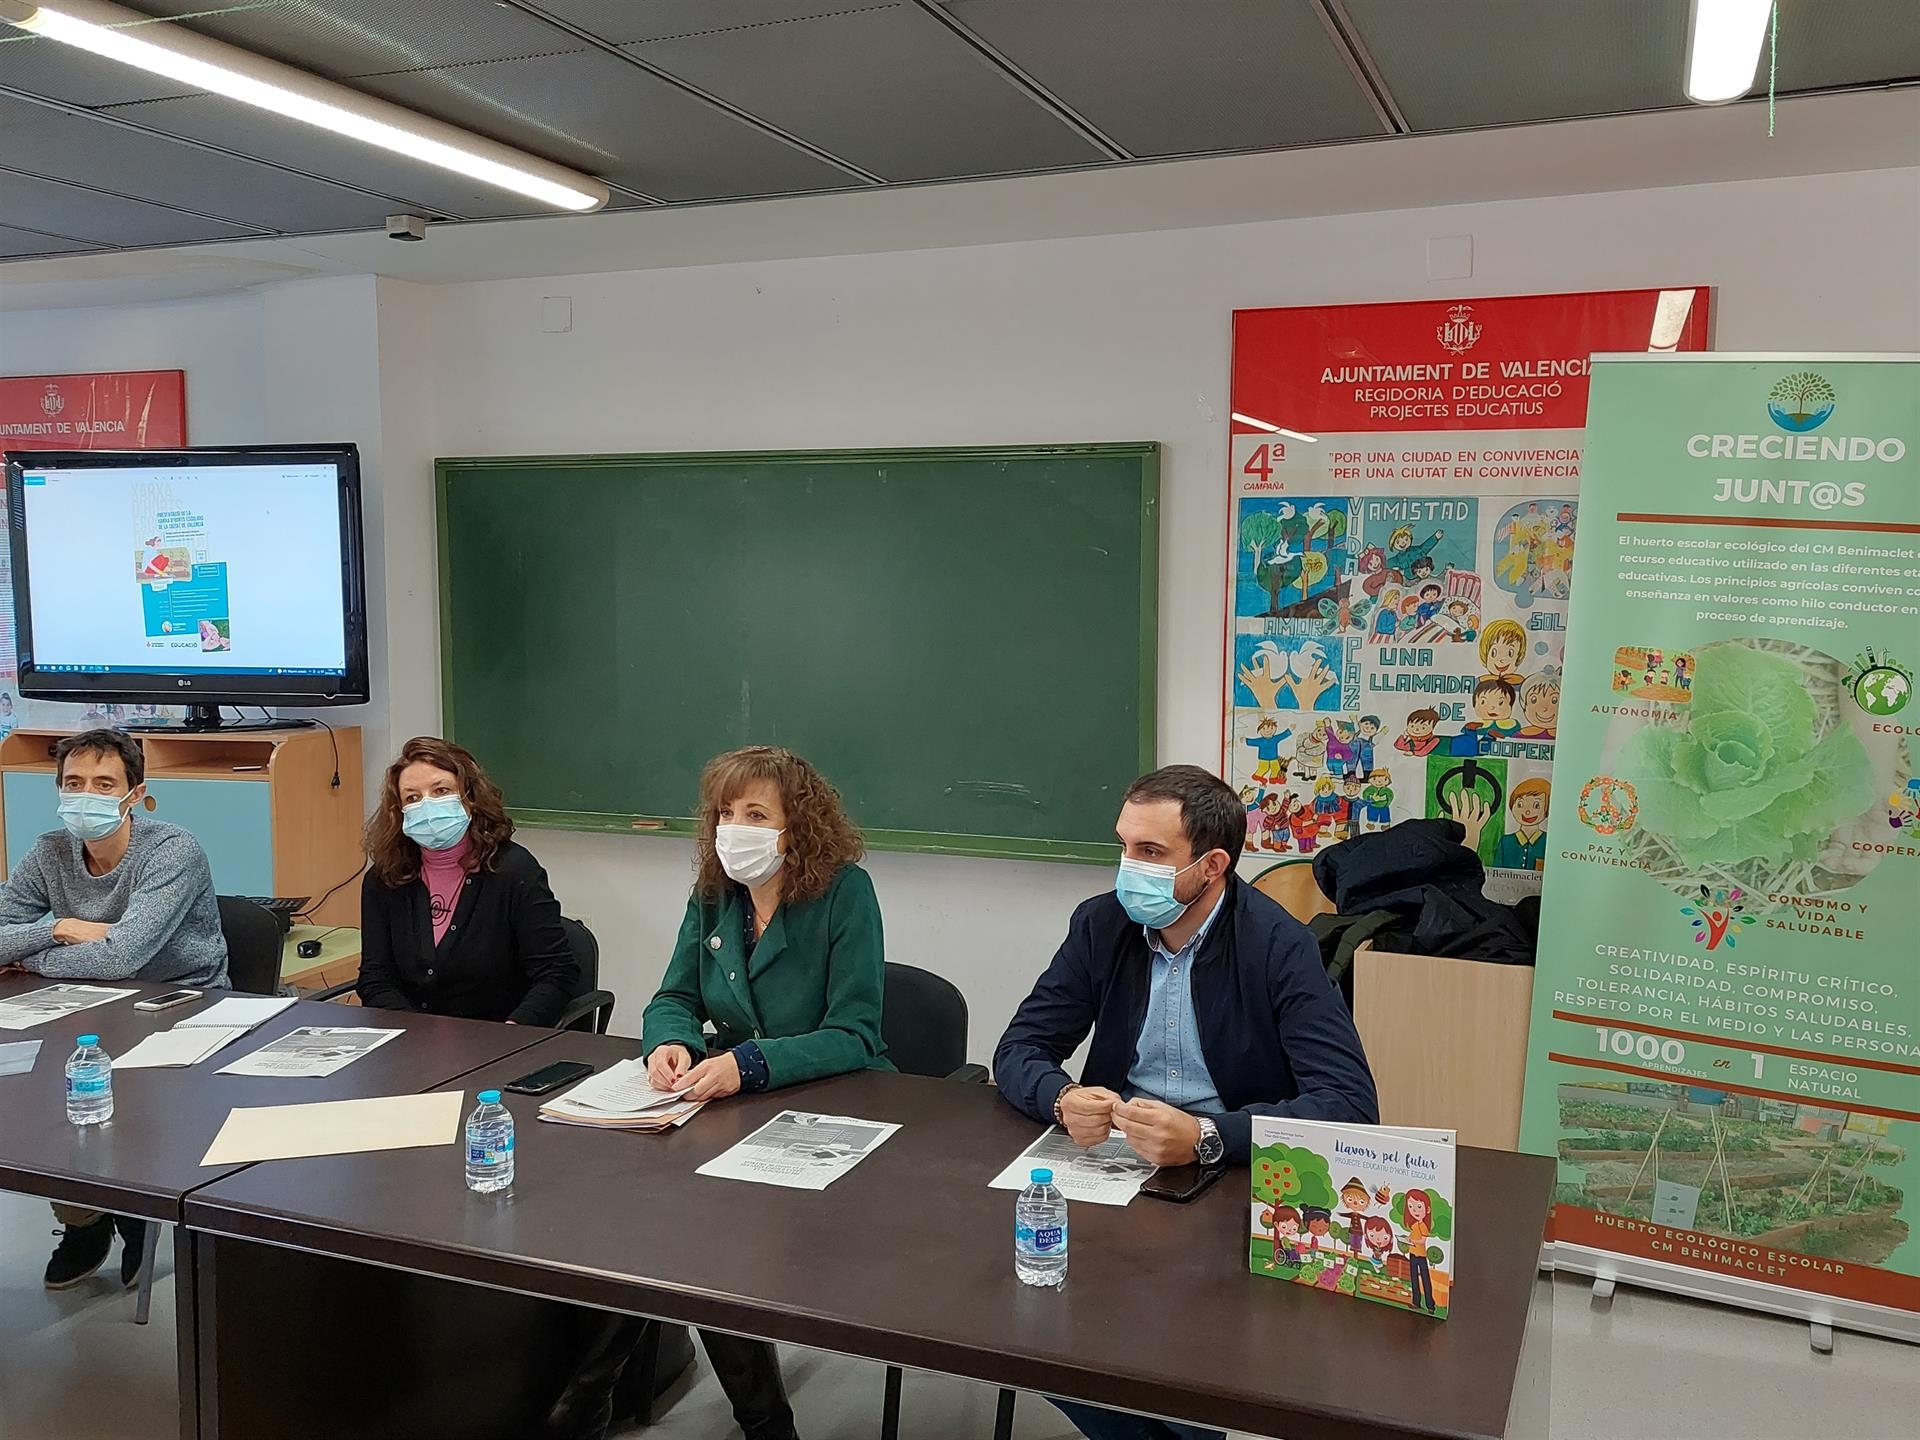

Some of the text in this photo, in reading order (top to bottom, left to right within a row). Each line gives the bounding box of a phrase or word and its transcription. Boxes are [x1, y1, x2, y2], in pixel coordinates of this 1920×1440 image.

[1320, 363, 1453, 384] AJUNTAMENT
[1462, 362, 1490, 380] DE
[1355, 380, 1562, 402] REGIDORIA D'EDUCACIÓ
[1370, 402, 1544, 421] PROJECTES EDUCATIUS
[57, 422, 71, 434] DE
[75, 420, 125, 433] VALENCIA
[1367, 452, 1395, 463] UNA
[1401, 451, 1452, 463] CIUDAD
[1458, 451, 1477, 462] EN
[1686, 433, 1906, 463] CRECIENDO
[1366, 467, 1395, 479] UNA
[1401, 467, 1448, 478] CIUTAT
[1454, 467, 1473, 478] EN
[1479, 463, 1579, 478] CONVIVÈNCIA
[1243, 481, 1285, 491] CAMPAÑA
[1713, 477, 1866, 511] JUNT@S
[1619, 536, 1630, 545] El
[1633, 536, 1673, 547] huerto
[1677, 539, 1721, 549] escolar
[1724, 541, 1786, 553] ecológico
[1789, 543, 1809, 554] del
[1812, 544, 1834, 554] CM
[1837, 546, 1914, 558] Benimaclet
[1619, 554, 1665, 564] recurso
[1668, 555, 1729, 567] educativo
[1733, 558, 1787, 570] utilizado
[1791, 563, 1807, 572] en
[1811, 562, 1829, 573] las
[1832, 563, 1900, 576] diferentes
[1618, 571, 1687, 583] educativas.
[1690, 574, 1711, 584] Los
[1714, 576, 1777, 588] principios
[1780, 580, 1839, 592] agrícolas
[1842, 583, 1903, 595] conviven
[1626, 589, 1918, 615] enseñanza en valores como hilo conductor en
[1264, 617, 1325, 636] AMOR
[1531, 611, 1568, 632] SOL
[1696, 611, 1848, 630] proceso de aprendizaje.
[1379, 648, 1433, 666] UNA
[1369, 673, 1476, 694] LLAMADA
[1438, 702, 1466, 721] DE
[1591, 704, 1679, 721] AUTONOMÍA
[1561, 850, 1652, 871] CONVIVENCIA
[1588, 844, 1626, 856] PAZ Y
[1768, 893, 1868, 914] CONSUMO Y
[1796, 909, 1836, 924] VIDA
[1766, 919, 1865, 940] SALUDABLE
[1726, 962, 1810, 985] ESPÍRITU
[1698, 995, 1778, 1018] HÁBITOS
[1554, 991, 1920, 1057] RESPETO POR EL MEDIO Y LAS PERSONA
[1595, 1028, 1765, 1079] 1000 en 1
[1641, 1061, 1709, 1078] APRENDIZAJES
[1789, 1063, 1858, 1083] ESPACIO
[1788, 1078, 1862, 1099] NATURAL
[1335, 1157, 1361, 1168] PROJECTE
[1362, 1161, 1388, 1173] EDUCATIU
[1411, 1169, 1436, 1181] ESCOLAR
[1382, 1151, 1400, 1164] pel
[1405, 1152, 1438, 1170] futur
[1038, 1229, 1061, 1237] AQUA
[1039, 1236, 1061, 1244] DEUS
[1594, 1214, 1846, 1276] HUERTO ECOLÓGICO ESCOLAR
[1651, 1240, 1787, 1278] CM BENIMACLET
